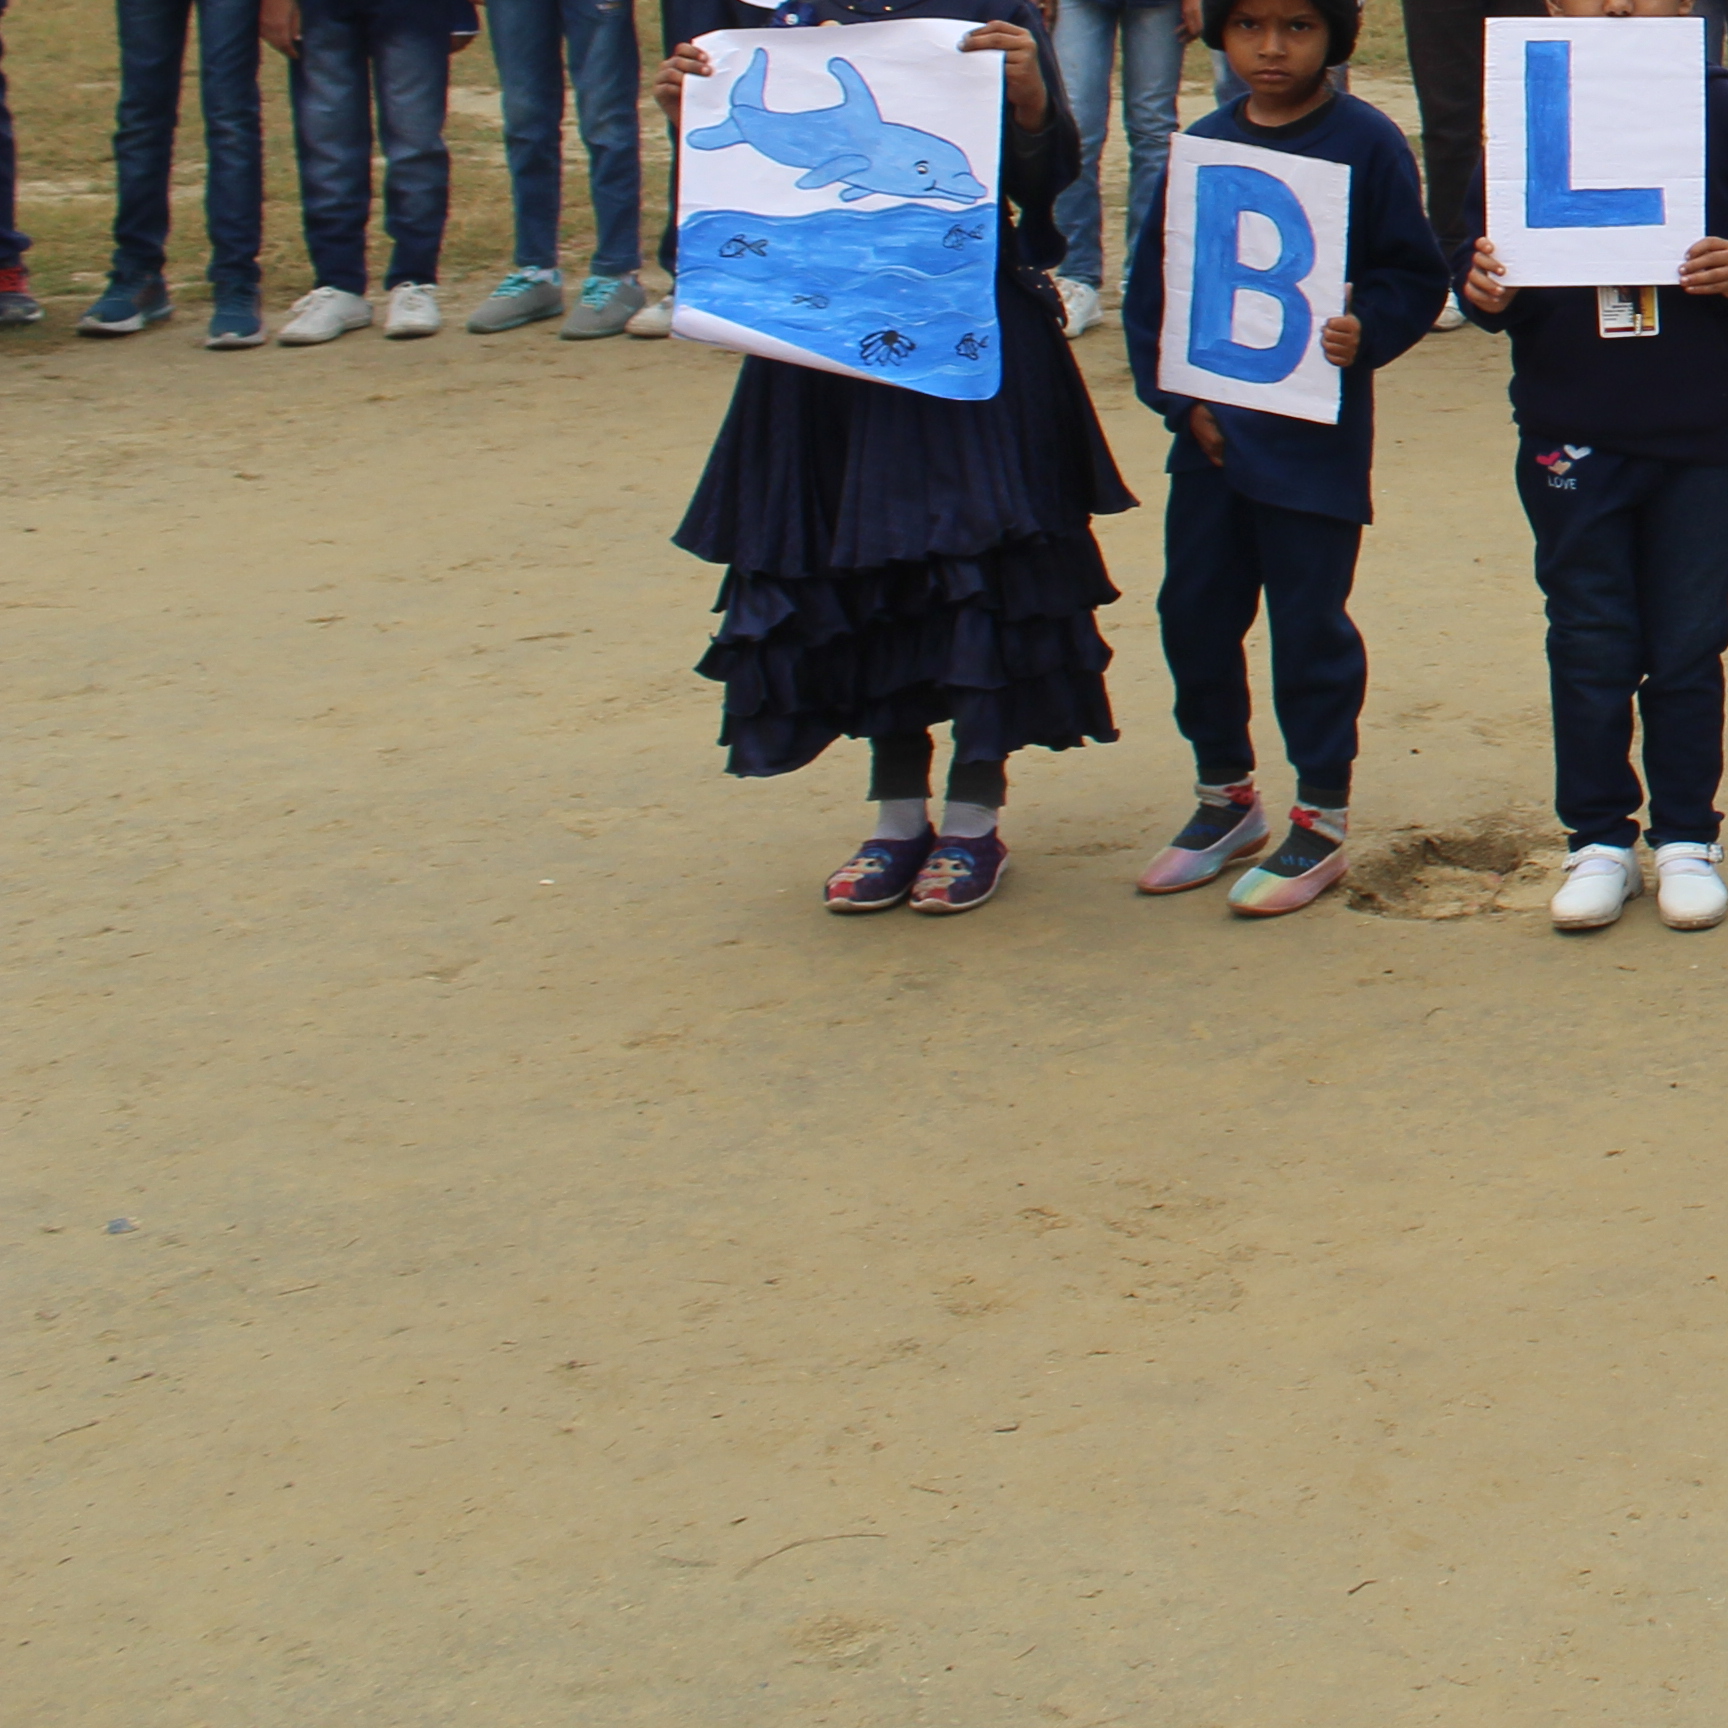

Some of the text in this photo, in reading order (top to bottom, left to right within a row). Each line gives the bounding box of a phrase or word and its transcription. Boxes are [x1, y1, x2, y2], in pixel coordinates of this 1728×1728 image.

[1525, 40, 1666, 228] L
[1187, 165, 1316, 384] B
[1547, 475, 1577, 490] LOVE
